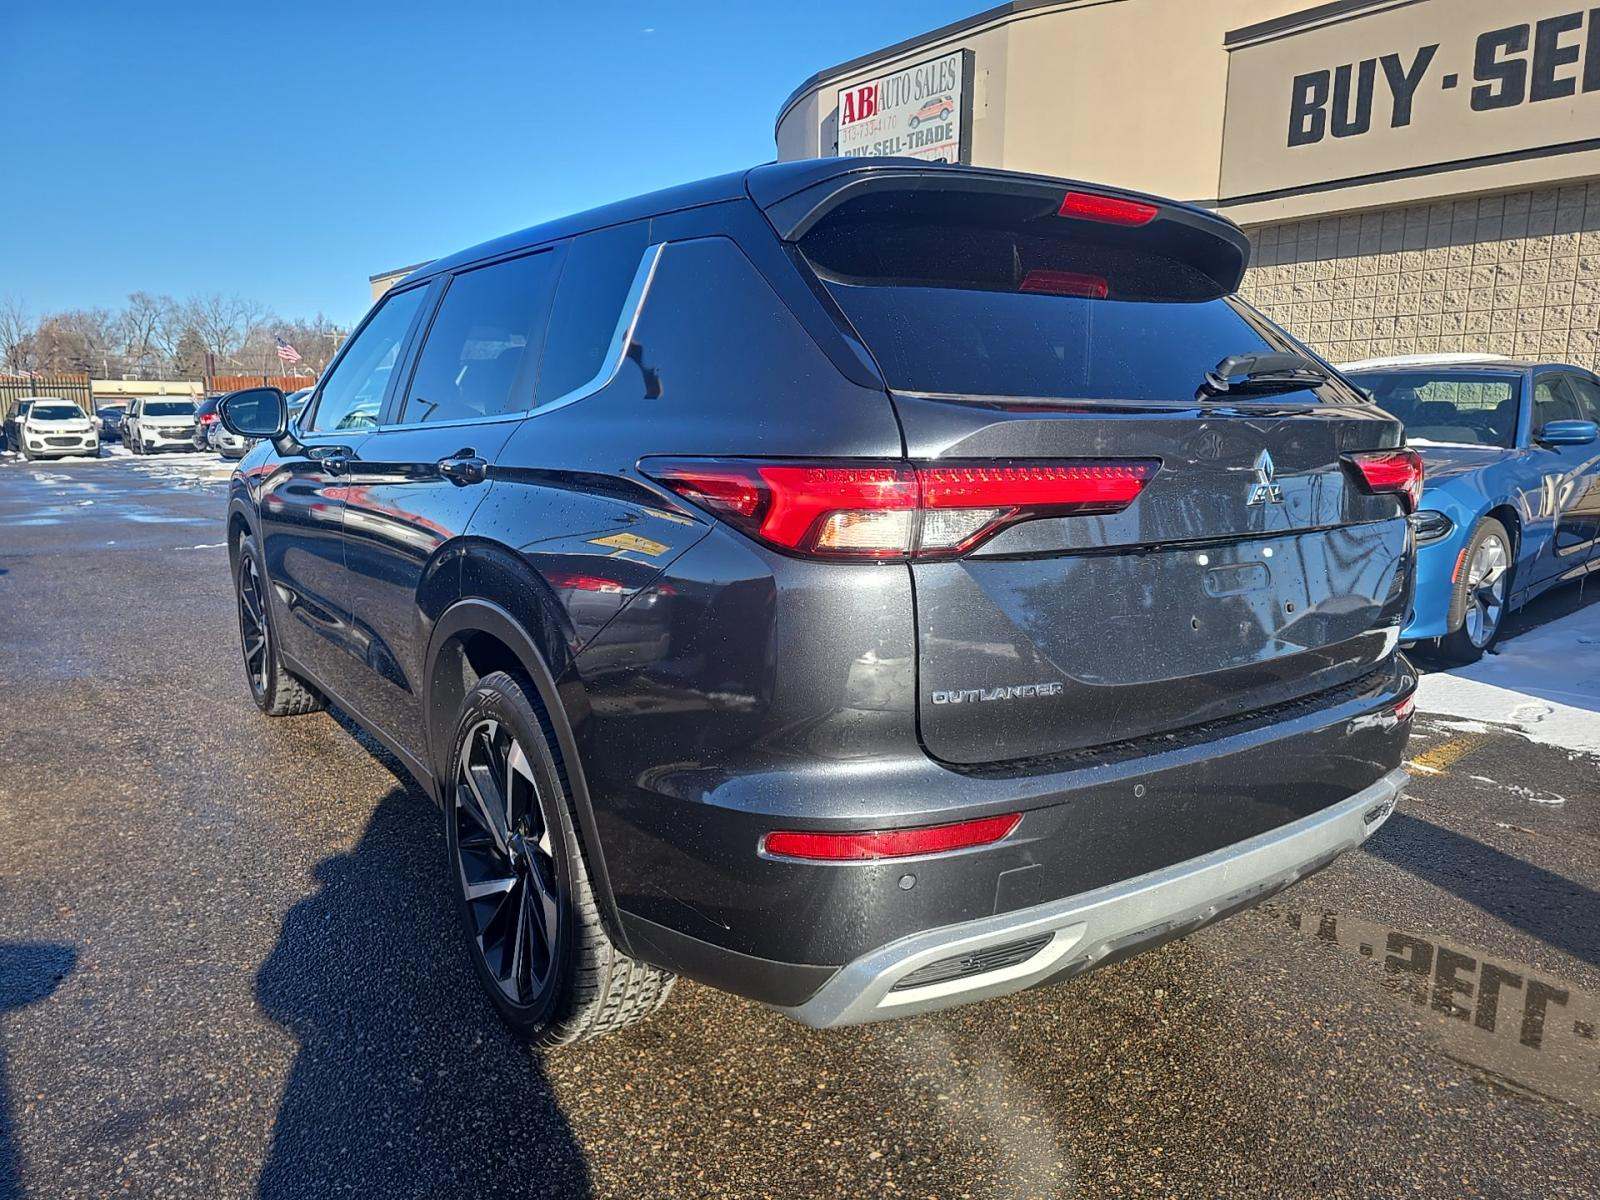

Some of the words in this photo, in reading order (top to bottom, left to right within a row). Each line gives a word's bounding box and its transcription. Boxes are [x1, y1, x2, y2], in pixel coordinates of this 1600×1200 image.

[879, 73, 911, 111] AUTO
[914, 58, 956, 101] SALES
[1287, 43, 1440, 147] BUY
[932, 682, 1063, 704] OUTLANDER
